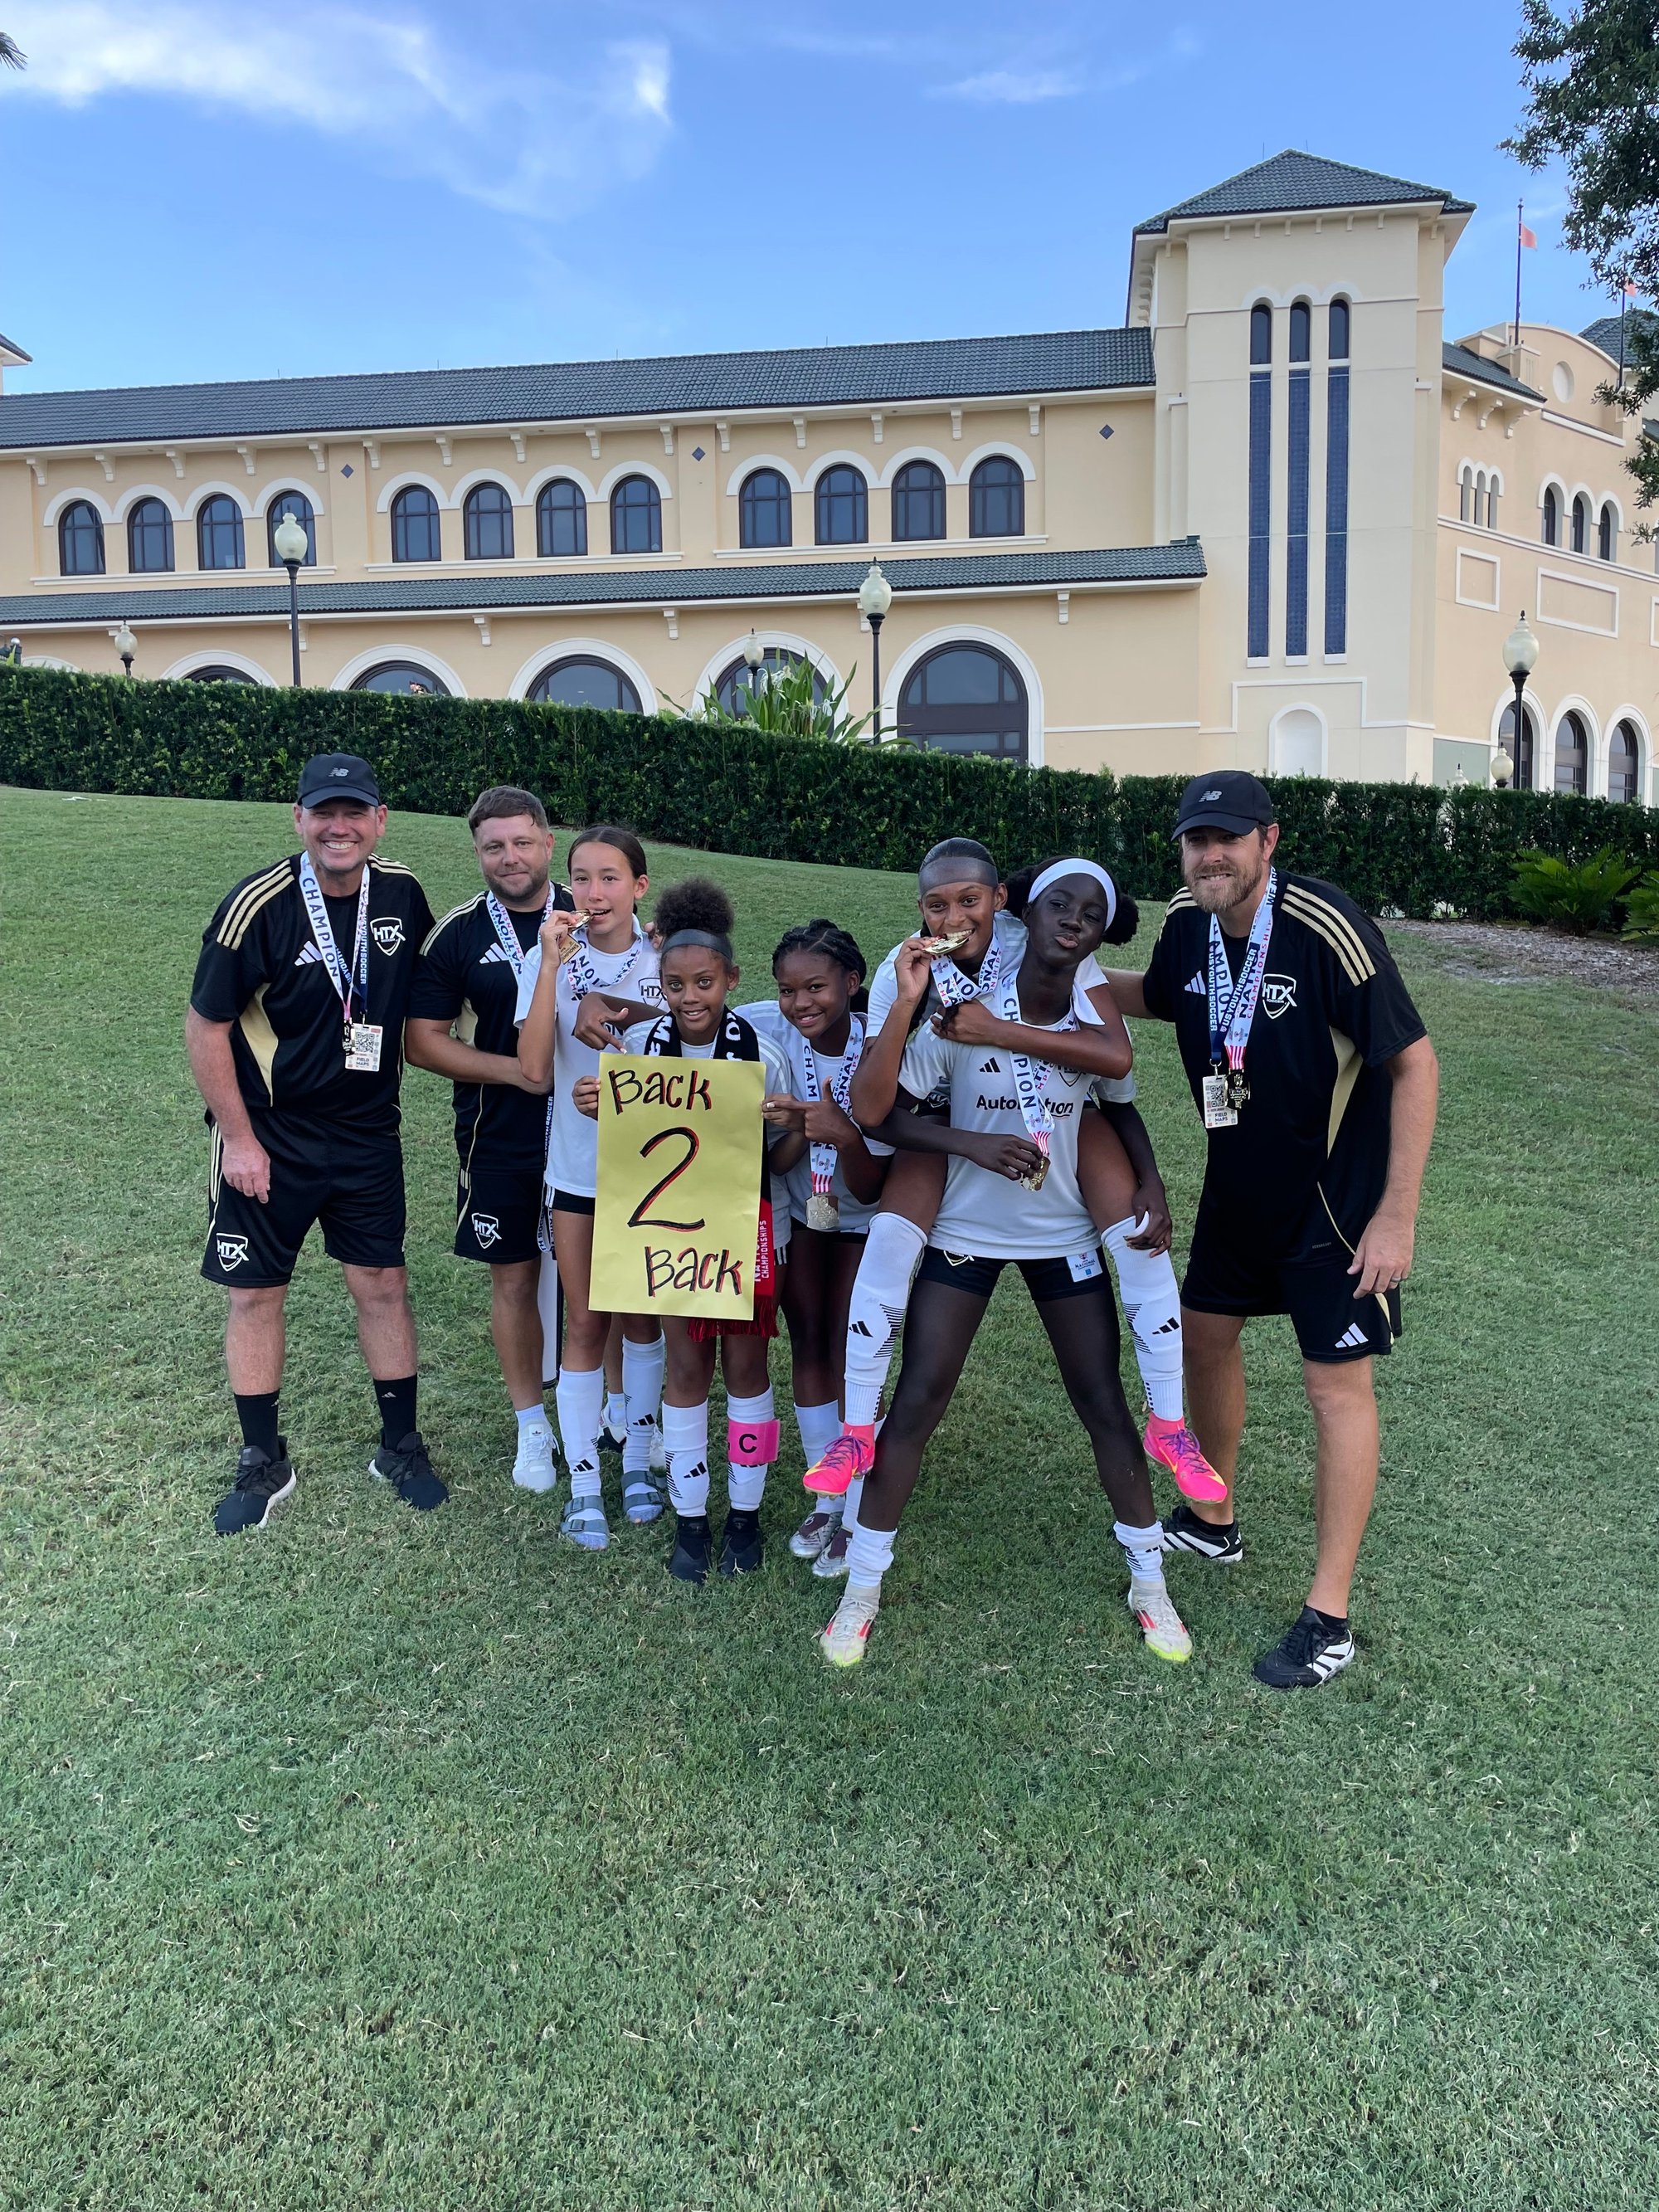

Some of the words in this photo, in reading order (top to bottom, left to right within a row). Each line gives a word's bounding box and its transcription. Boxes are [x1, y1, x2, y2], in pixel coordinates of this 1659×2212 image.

[1198, 790, 1223, 802] NB
[302, 877, 339, 977] CHAMPION
[373, 925, 406, 942] HTX
[489, 896, 523, 975] NATIONAL
[640, 985, 667, 1001] HTX
[1209, 953, 1218, 1032] USYOUTHSOCCER
[1222, 948, 1258, 1026] USYOUTHSOCCER
[1262, 982, 1297, 1006] HTX
[608, 1069, 712, 1115] Back
[976, 1095, 1073, 1114] Autotion
[627, 1126, 705, 1233] 2
[474, 1220, 502, 1240] HTX
[217, 1240, 249, 1261] HTX
[760, 1220, 770, 1279] CHAMPIONSHIPS
[645, 1246, 743, 1298] Back
[739, 1433, 757, 1454] C
